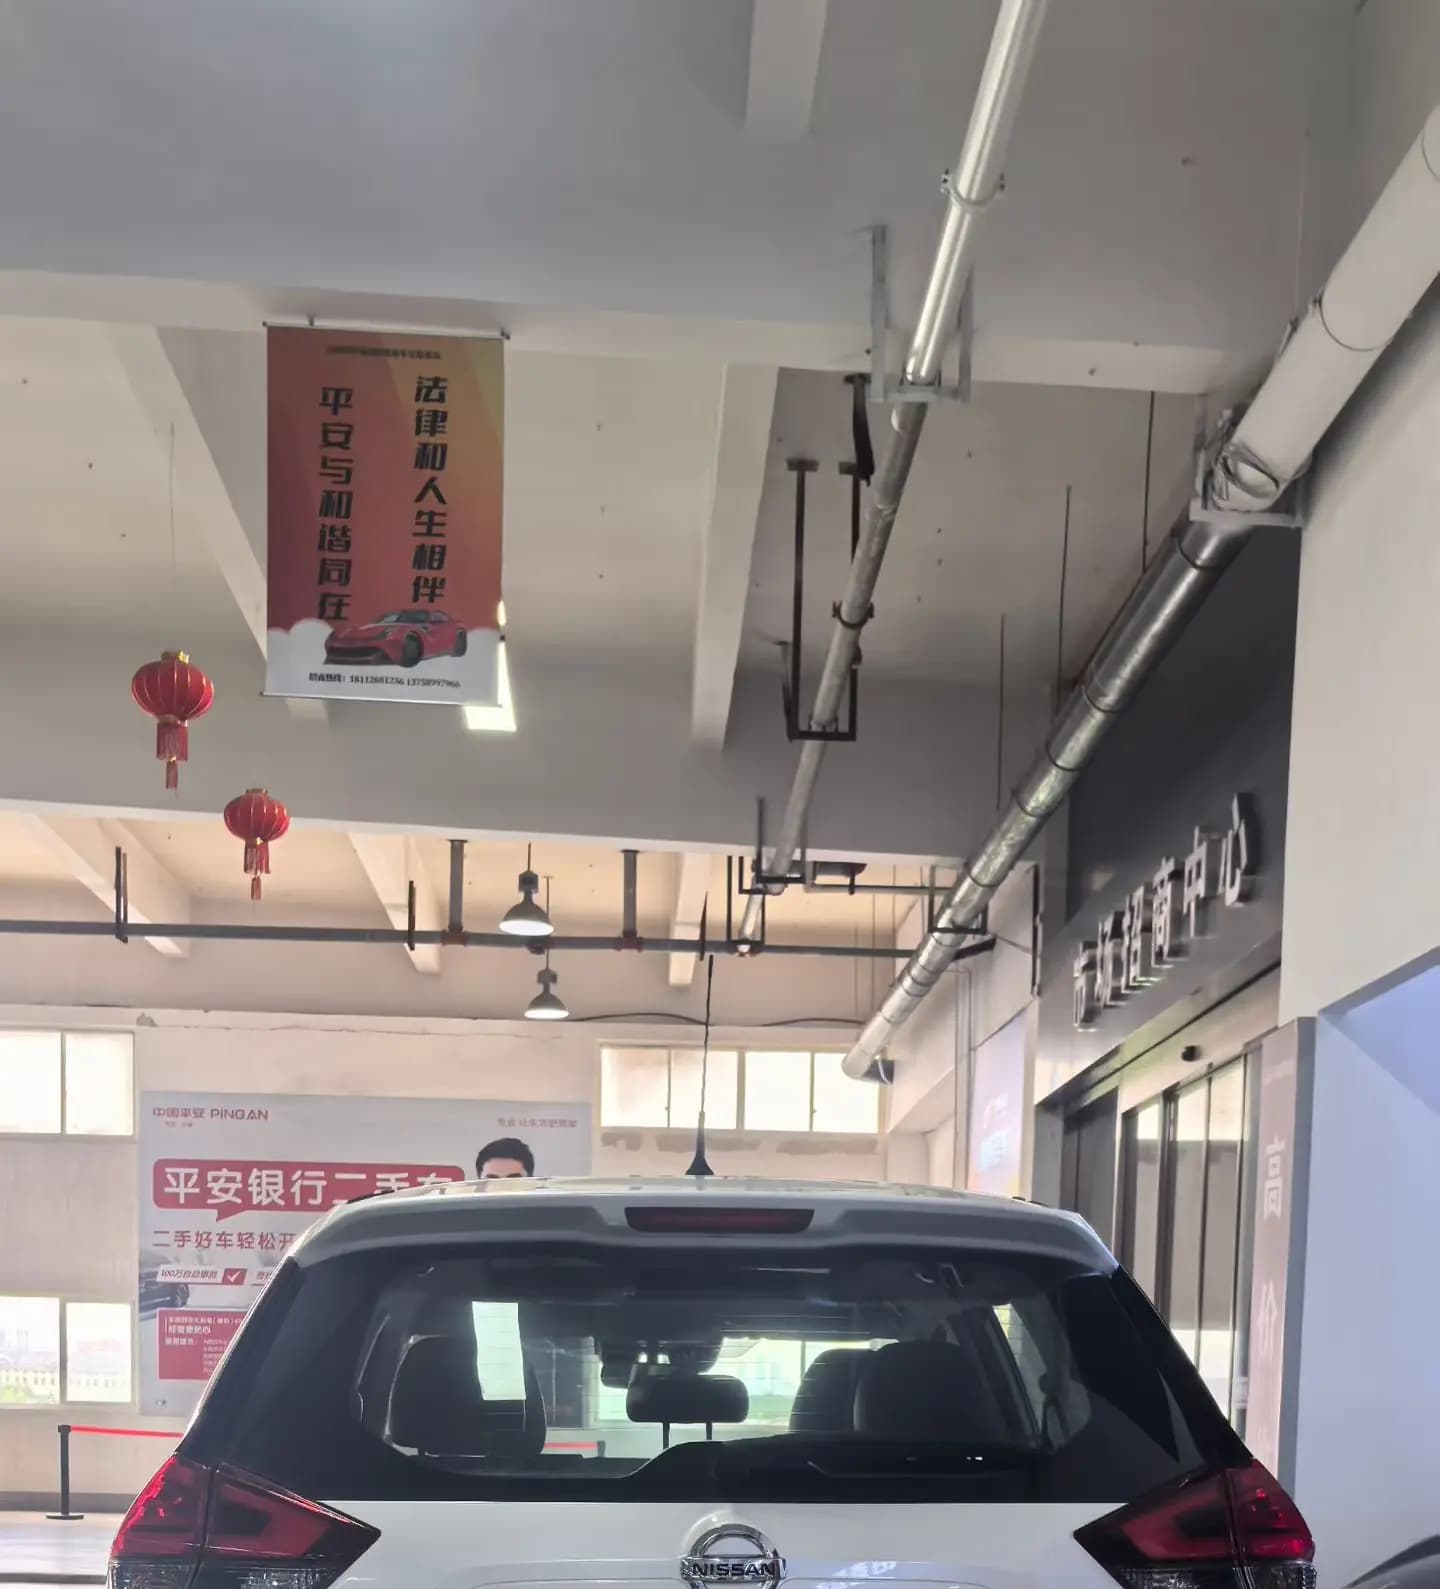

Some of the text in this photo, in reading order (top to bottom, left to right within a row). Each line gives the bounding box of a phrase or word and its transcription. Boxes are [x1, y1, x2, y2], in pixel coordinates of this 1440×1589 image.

[318, 387, 354, 622] 平安与和谐同在
[413, 376, 448, 603] 法律和人生相伴
[692, 1562, 776, 1578] NISSAN
